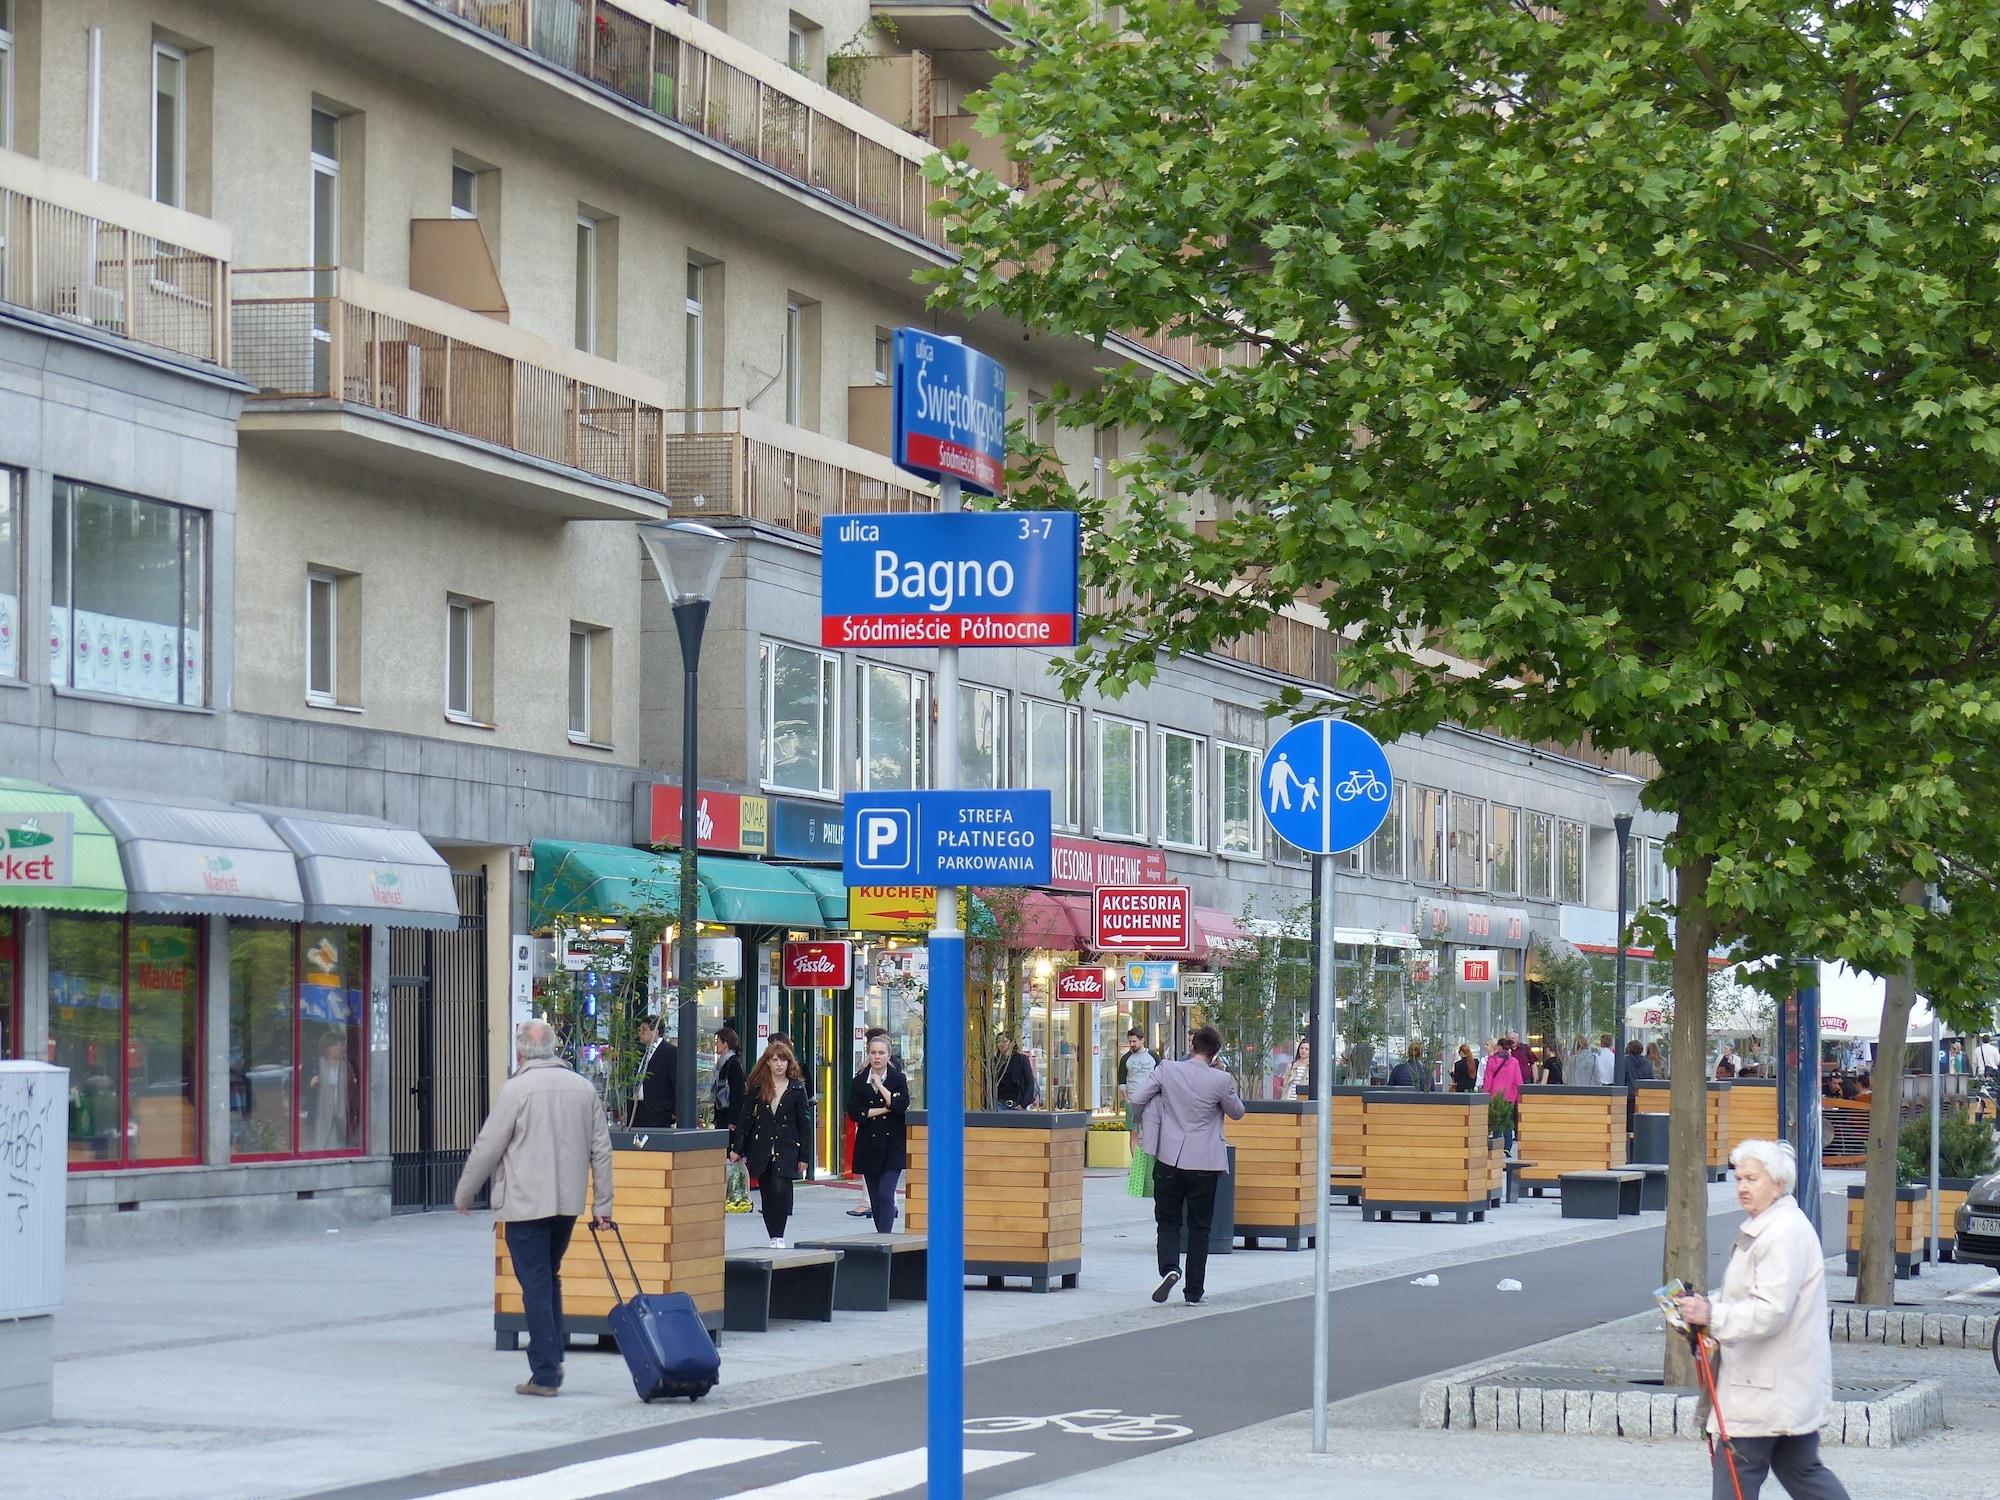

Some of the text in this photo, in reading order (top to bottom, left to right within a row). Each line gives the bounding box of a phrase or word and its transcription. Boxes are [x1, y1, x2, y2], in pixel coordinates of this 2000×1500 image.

[916, 337, 934, 362] ulica
[917, 361, 1003, 452] Świętokrzyska
[939, 441, 976, 475] Śródmieście
[840, 518, 1052, 542] ulica 3-7
[875, 550, 1015, 611] Bagno
[843, 616, 1050, 641] Śródmieście Północne
[743, 802, 765, 828] IRMAR
[959, 809, 1013, 823] STREFA
[823, 822, 845, 846] PHILIP
[868, 817, 898, 860] P
[938, 830, 1035, 847] PŁATNEGO
[0, 854, 54, 880] ket
[938, 856, 1034, 870] PARKOWANIA
[1051, 847, 1093, 883] KCESORIA
[203, 872, 239, 892] Market
[860, 886, 936, 898] KUCHEN
[372, 886, 403, 904] Market
[1102, 896, 1181, 910] AKCESORIA
[1103, 914, 1181, 928] KUCHENNE
[793, 955, 836, 973] Fissler
[137, 962, 188, 991] Market
[1060, 975, 1102, 993] Fissler
